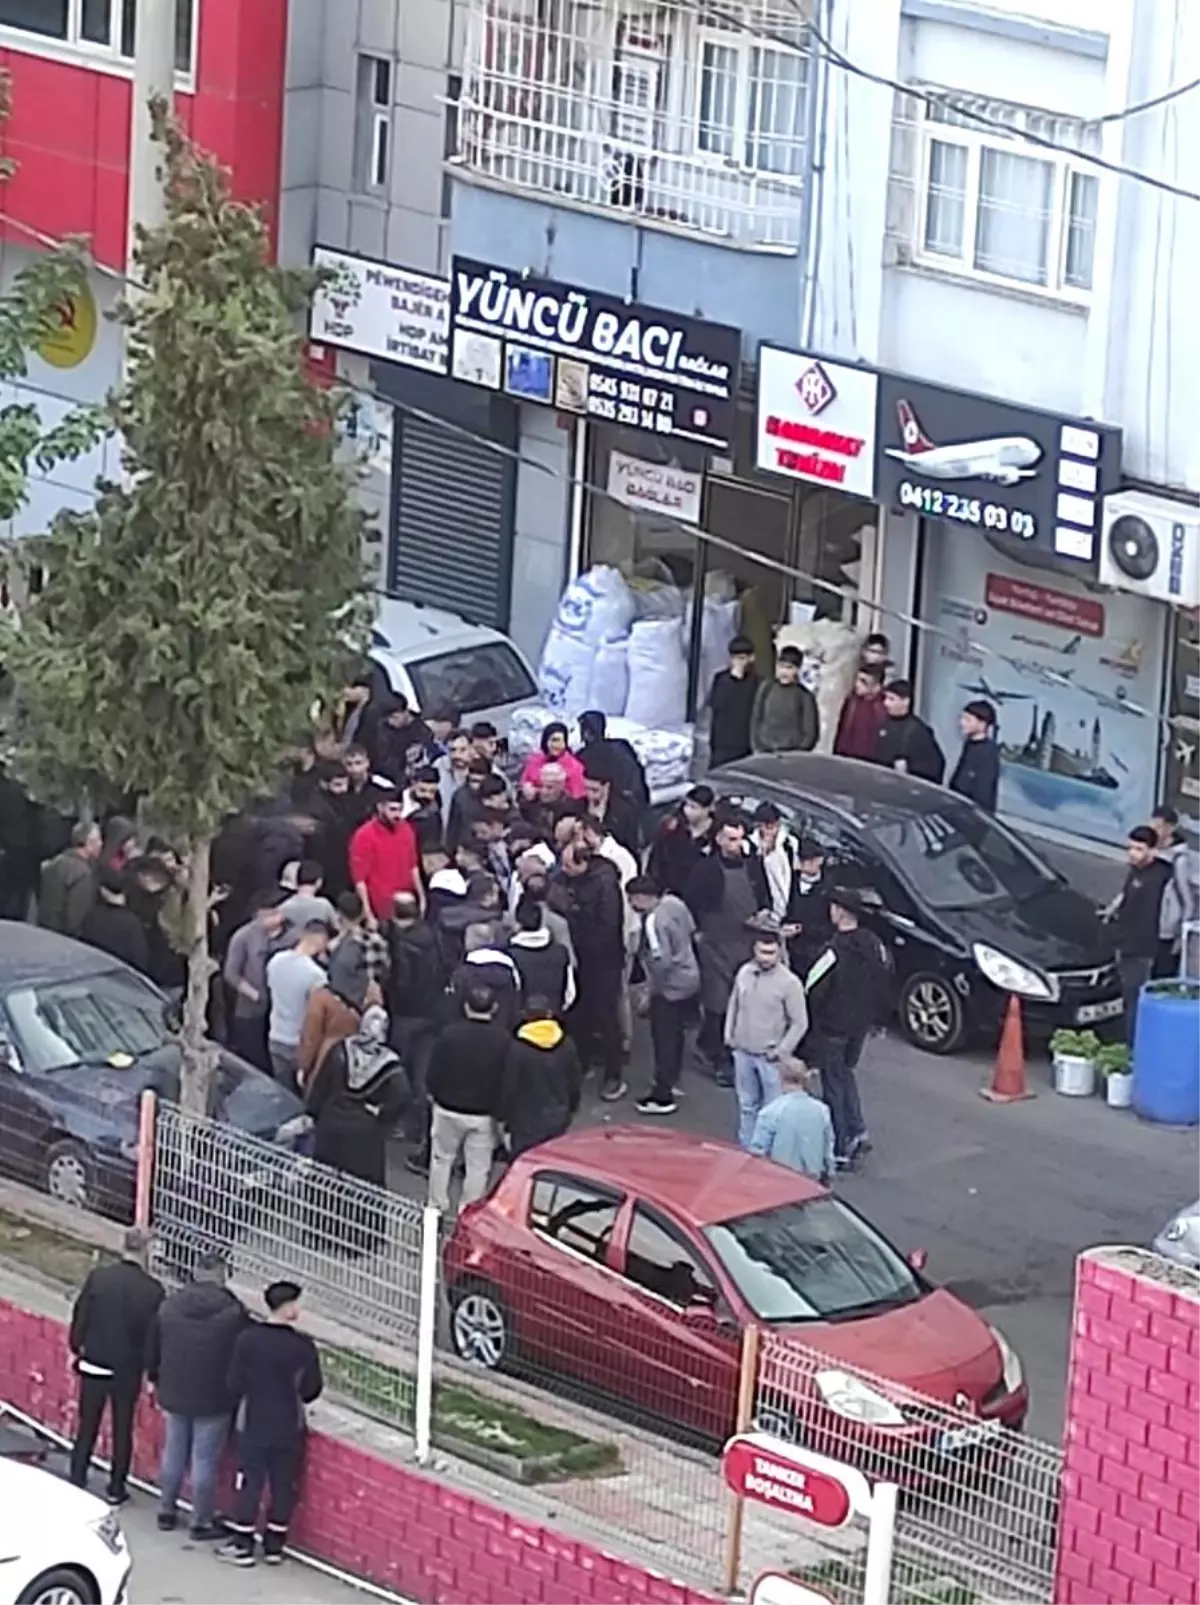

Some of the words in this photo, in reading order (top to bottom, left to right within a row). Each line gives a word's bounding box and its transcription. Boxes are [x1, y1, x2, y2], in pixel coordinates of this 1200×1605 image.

[457, 270, 588, 342] YÜNCÜ
[592, 312, 683, 369] BACI
[900, 481, 943, 512] 0412
[947, 494, 981, 523] 235
[984, 504, 1007, 529] 03
[1011, 511, 1035, 538] 03
